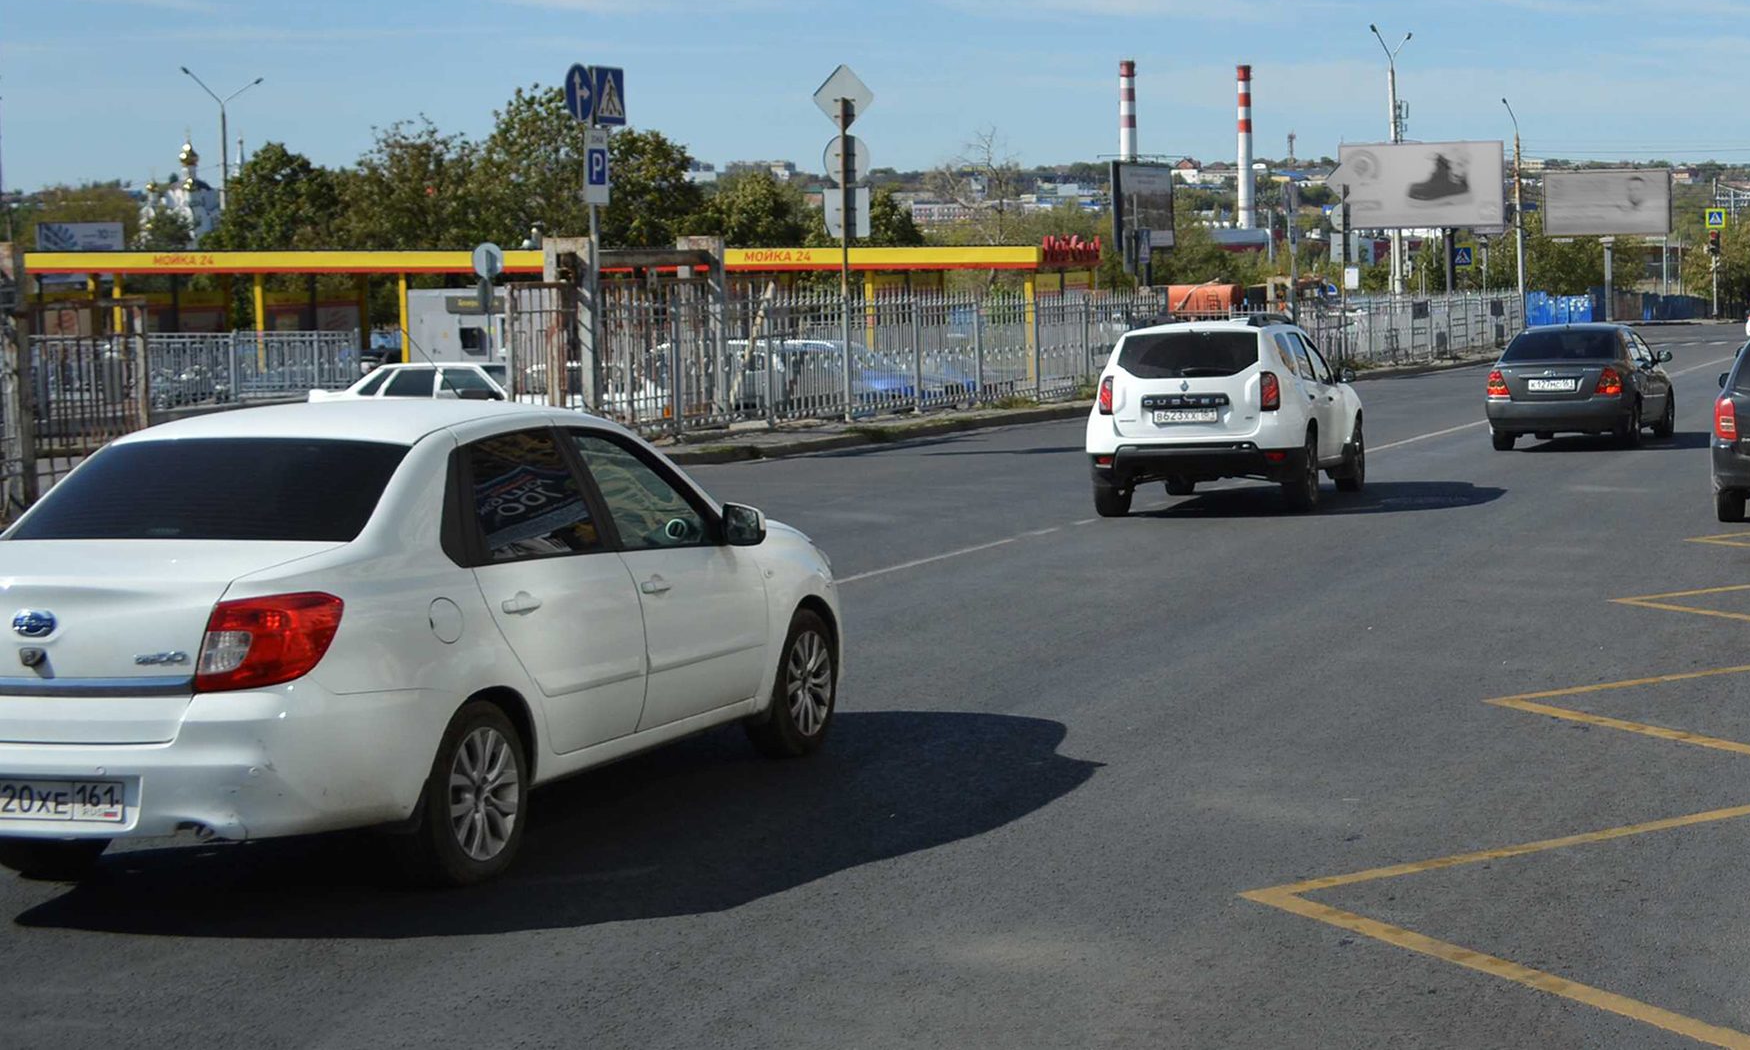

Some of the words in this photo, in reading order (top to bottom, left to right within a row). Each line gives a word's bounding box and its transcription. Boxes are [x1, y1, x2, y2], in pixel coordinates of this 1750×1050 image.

[153, 255, 197, 266] МОЙКА
[200, 255, 213, 265] 24
[744, 250, 791, 262] МОЙКА
[796, 251, 811, 261] 24
[1144, 396, 1225, 406] DUSTER
